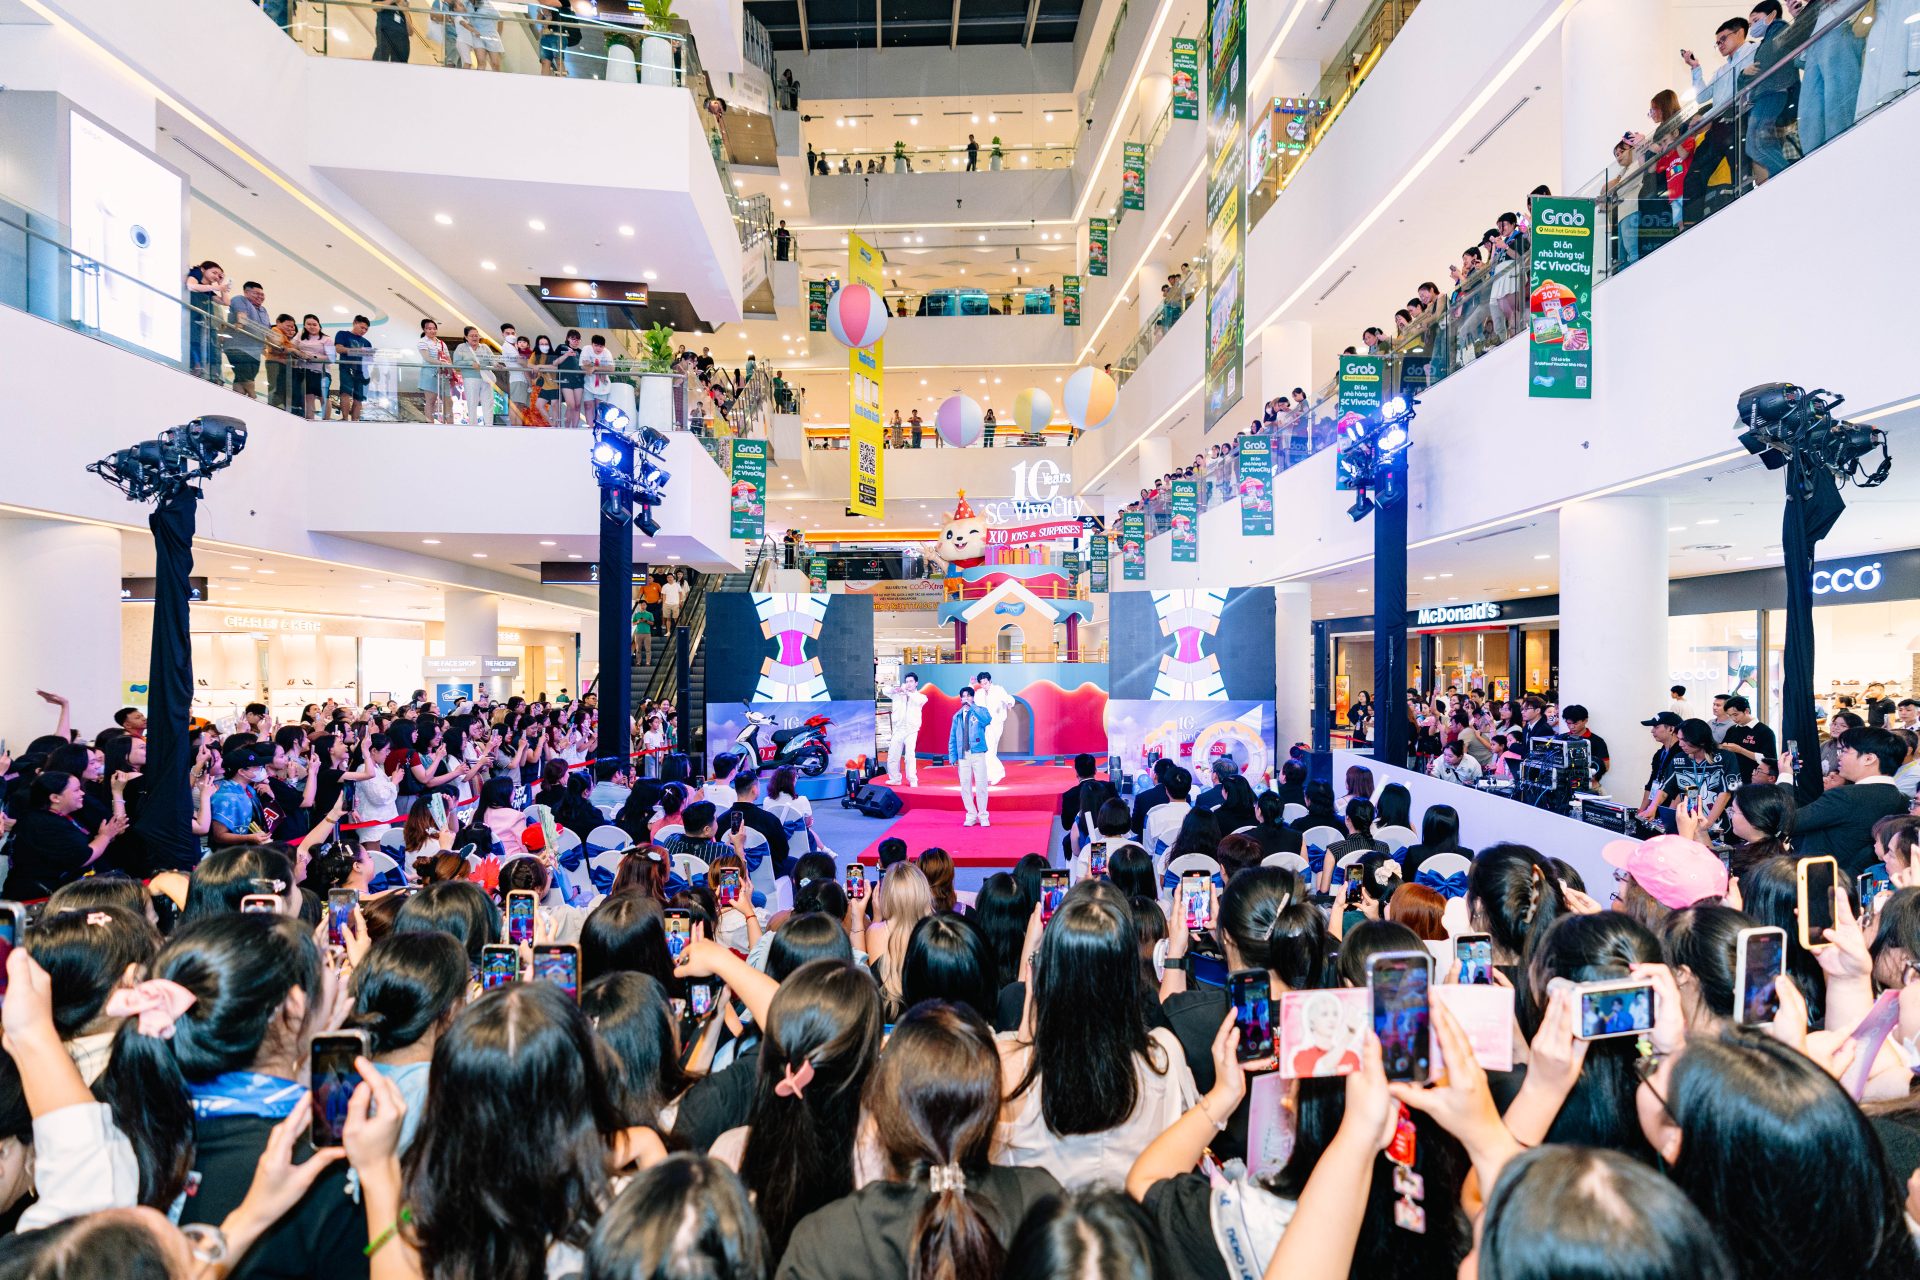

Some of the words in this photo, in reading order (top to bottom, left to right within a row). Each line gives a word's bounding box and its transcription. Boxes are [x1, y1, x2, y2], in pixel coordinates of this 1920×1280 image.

[1175, 42, 1194, 50] Grab
[1214, 103, 1236, 158] Grab
[1542, 209, 1585, 226] Grab
[1562, 241, 1573, 249] ăn
[1538, 250, 1553, 258] nhà
[1554, 250, 1574, 260] hàng
[1533, 261, 1547, 270] SC
[1548, 261, 1591, 275] VivoCity
[591, 290, 597, 298] 3
[1542, 290, 1561, 299] 30%
[1346, 363, 1376, 375] Grab
[1351, 398, 1380, 407] VivoCity
[738, 444, 762, 453] Grab
[1244, 441, 1266, 450] Grab
[1011, 459, 1060, 501] 10
[1042, 471, 1071, 485] Years
[1175, 485, 1193, 493] Grab
[985, 502, 1010, 525] SC
[1012, 496, 1085, 522] VivoCity
[989, 530, 1008, 544] X10
[1011, 532, 1028, 542] JOYS
[1039, 525, 1080, 537] SURPRISES
[1812, 562, 1882, 594] cco
[1418, 603, 1499, 624] McDonald's
[224, 616, 277, 629] CHARLES
